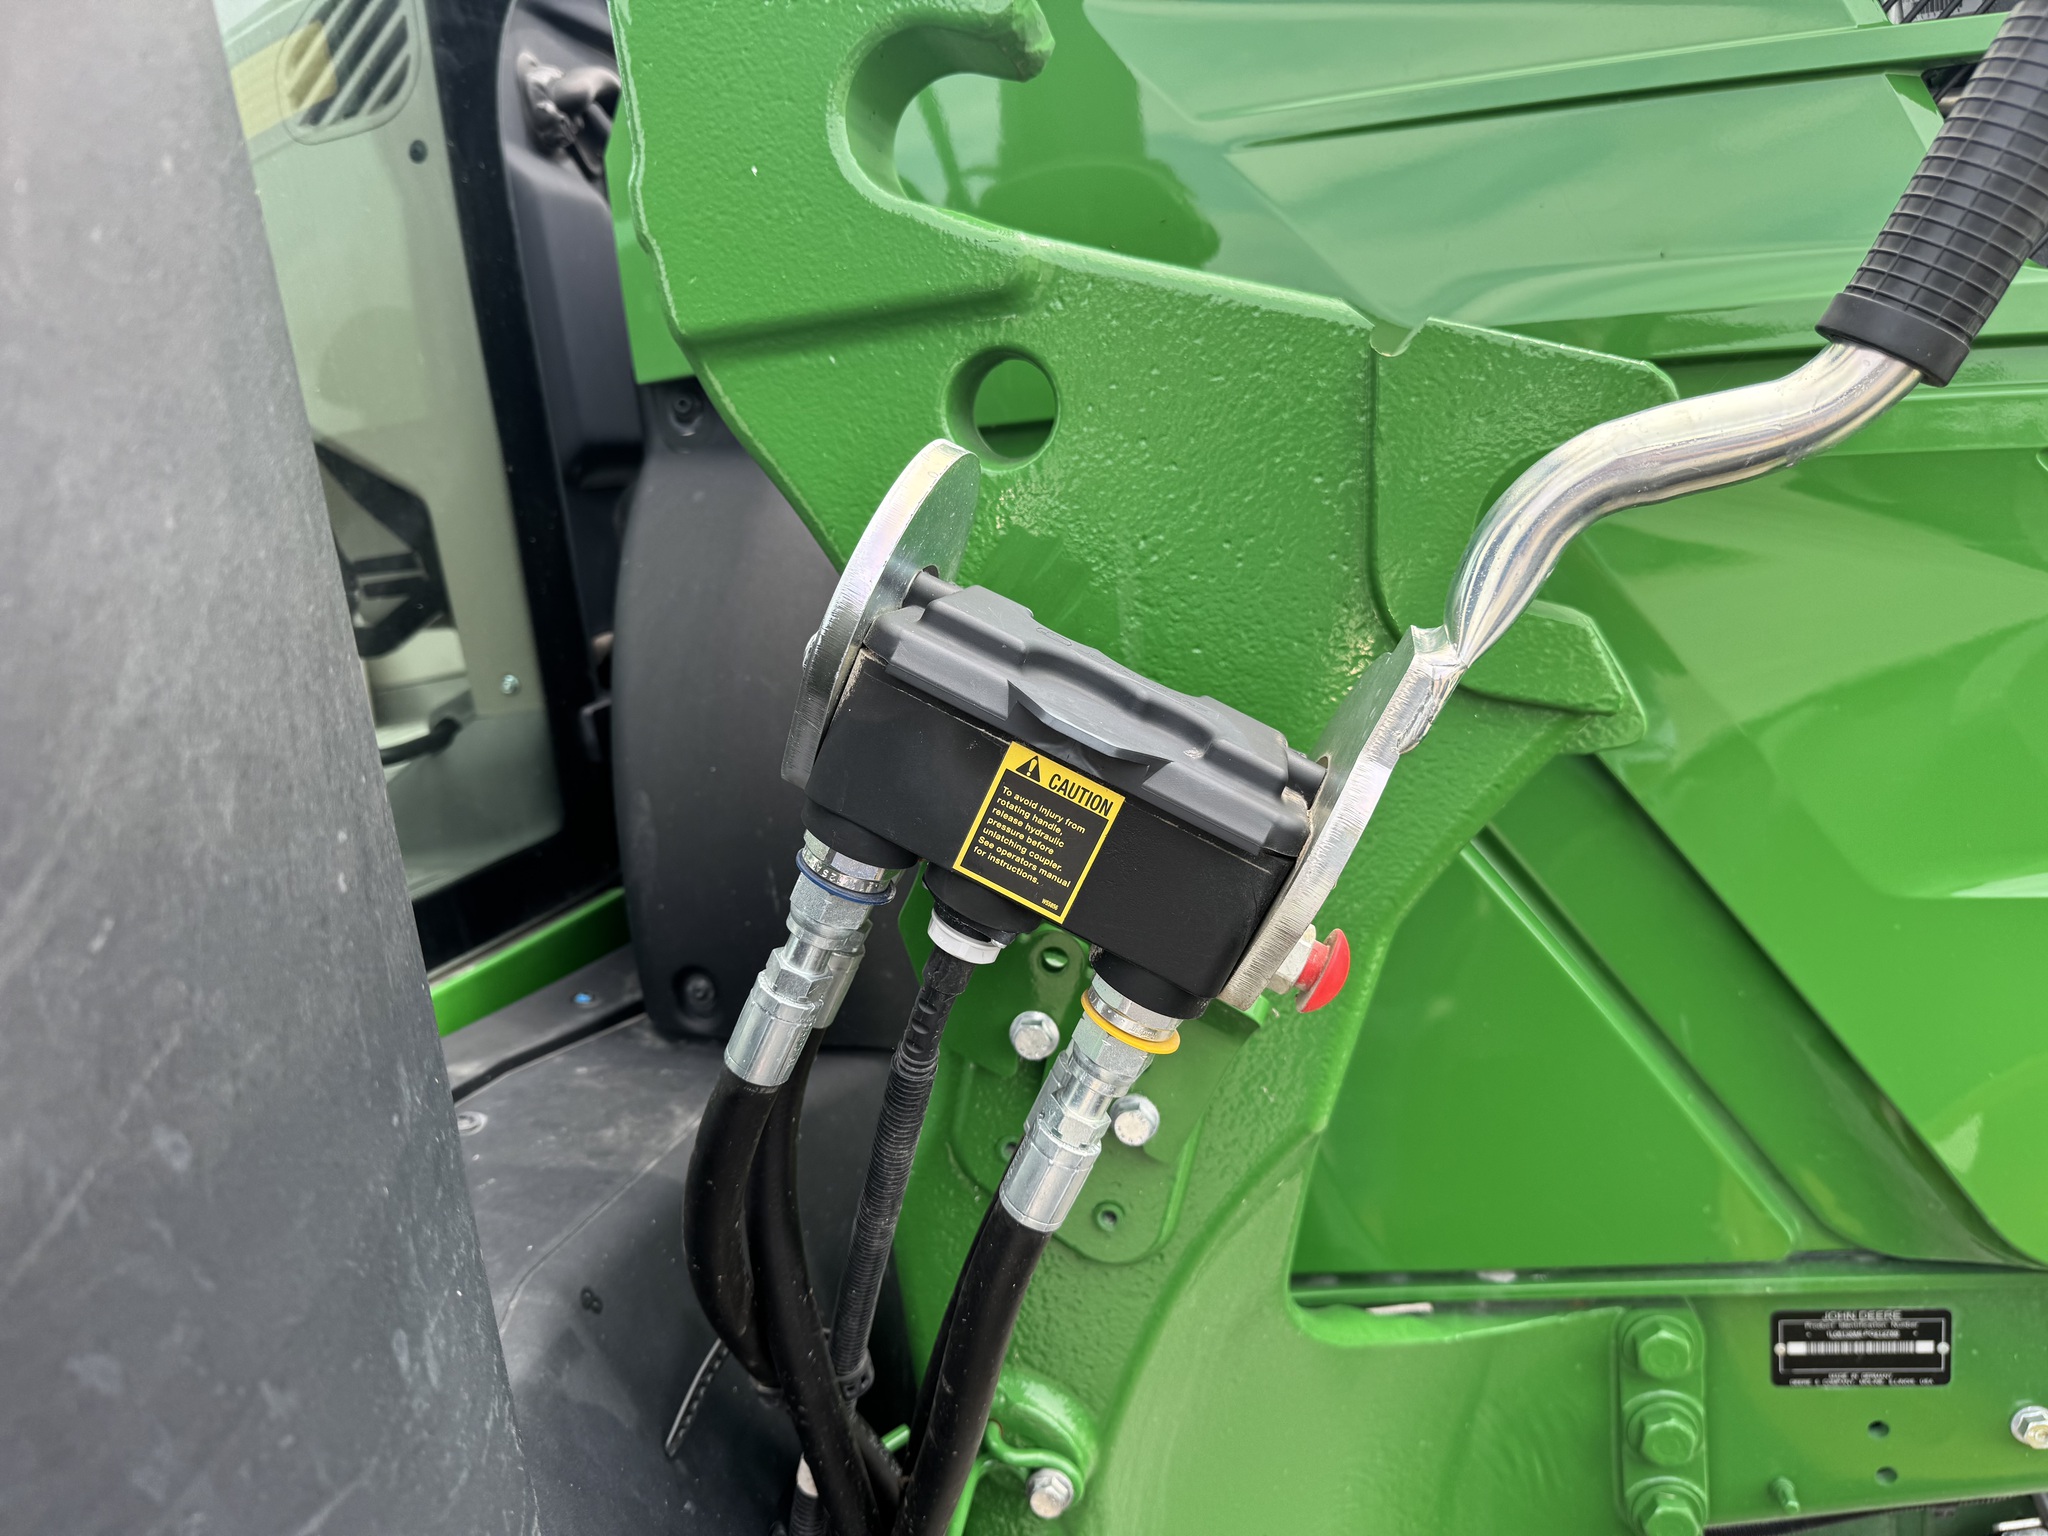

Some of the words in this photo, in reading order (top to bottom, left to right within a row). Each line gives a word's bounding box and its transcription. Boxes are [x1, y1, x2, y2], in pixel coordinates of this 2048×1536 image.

[1003, 786, 1012, 796] To
[1014, 794, 1038, 809] avoid
[1039, 805, 1064, 823] injury
[1065, 818, 1085, 834] from
[1048, 773, 1114, 817] CAUTION
[992, 808, 1023, 827] release
[1025, 823, 1064, 847] hydraulic
[997, 798, 1031, 819] rotating
[1032, 814, 1062, 836] handle,
[983, 827, 1027, 855] unlatching
[1029, 851, 1062, 872] coupler.
[987, 818, 1024, 840] pressure
[1026, 836, 1054, 855] before
[974, 846, 986, 856] for
[987, 853, 1039, 884] instructions.
[978, 836, 994, 849] See
[996, 847, 1037, 871] operators
[1039, 868, 1071, 888] manual
[1804, 1321, 1833, 1330] Product
[1838, 1321, 1886, 1329] Identification
[1890, 1320, 1918, 1329] Number
[1822, 1310, 1856, 1322] JOHN
[1859, 1310, 1902, 1321] DEERE
